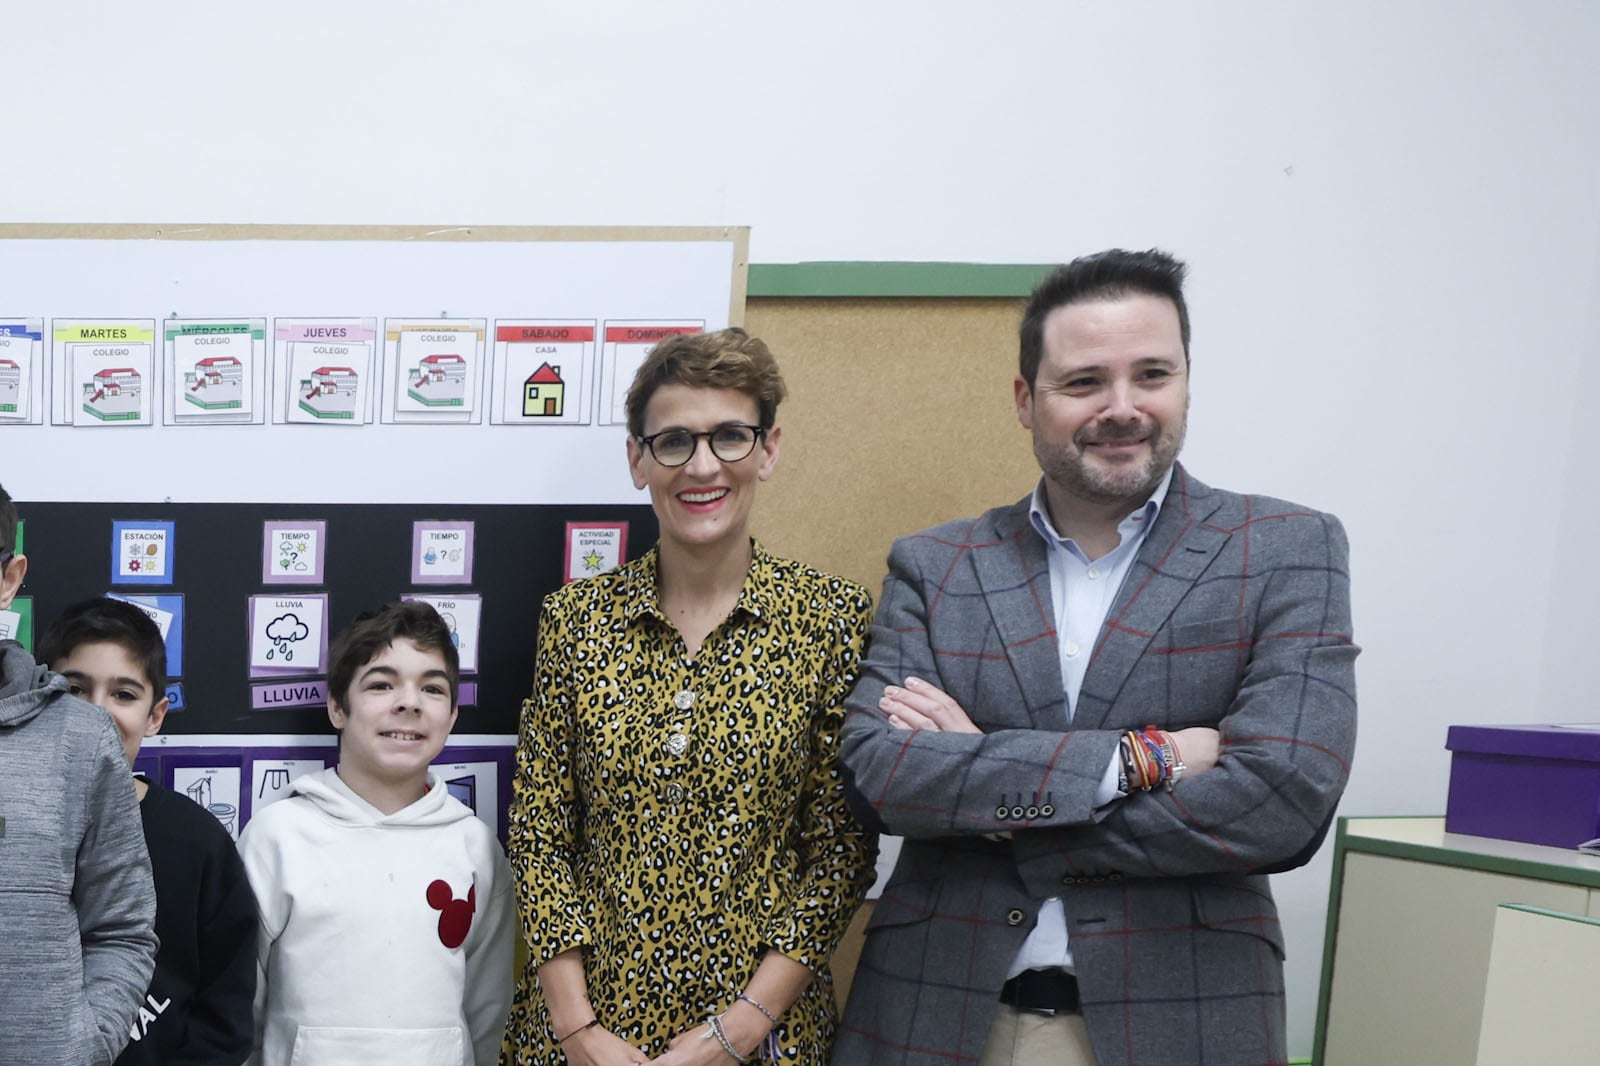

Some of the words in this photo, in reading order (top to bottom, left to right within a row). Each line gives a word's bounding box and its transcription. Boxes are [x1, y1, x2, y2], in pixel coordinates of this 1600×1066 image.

[80, 328, 128, 339] MARTES
[303, 327, 347, 338] JUEVES
[194, 336, 231, 345] COLEGIO
[420, 334, 457, 343] COLEGIO
[92, 348, 130, 357] COLEGIO
[312, 345, 349, 355] COLEGIO
[535, 346, 558, 354] CASA
[124, 532, 164, 541] ESTACIÓN
[281, 532, 310, 541] TIEMPO
[430, 532, 459, 541] TIEMPO
[263, 686, 320, 703] LLUVIA
